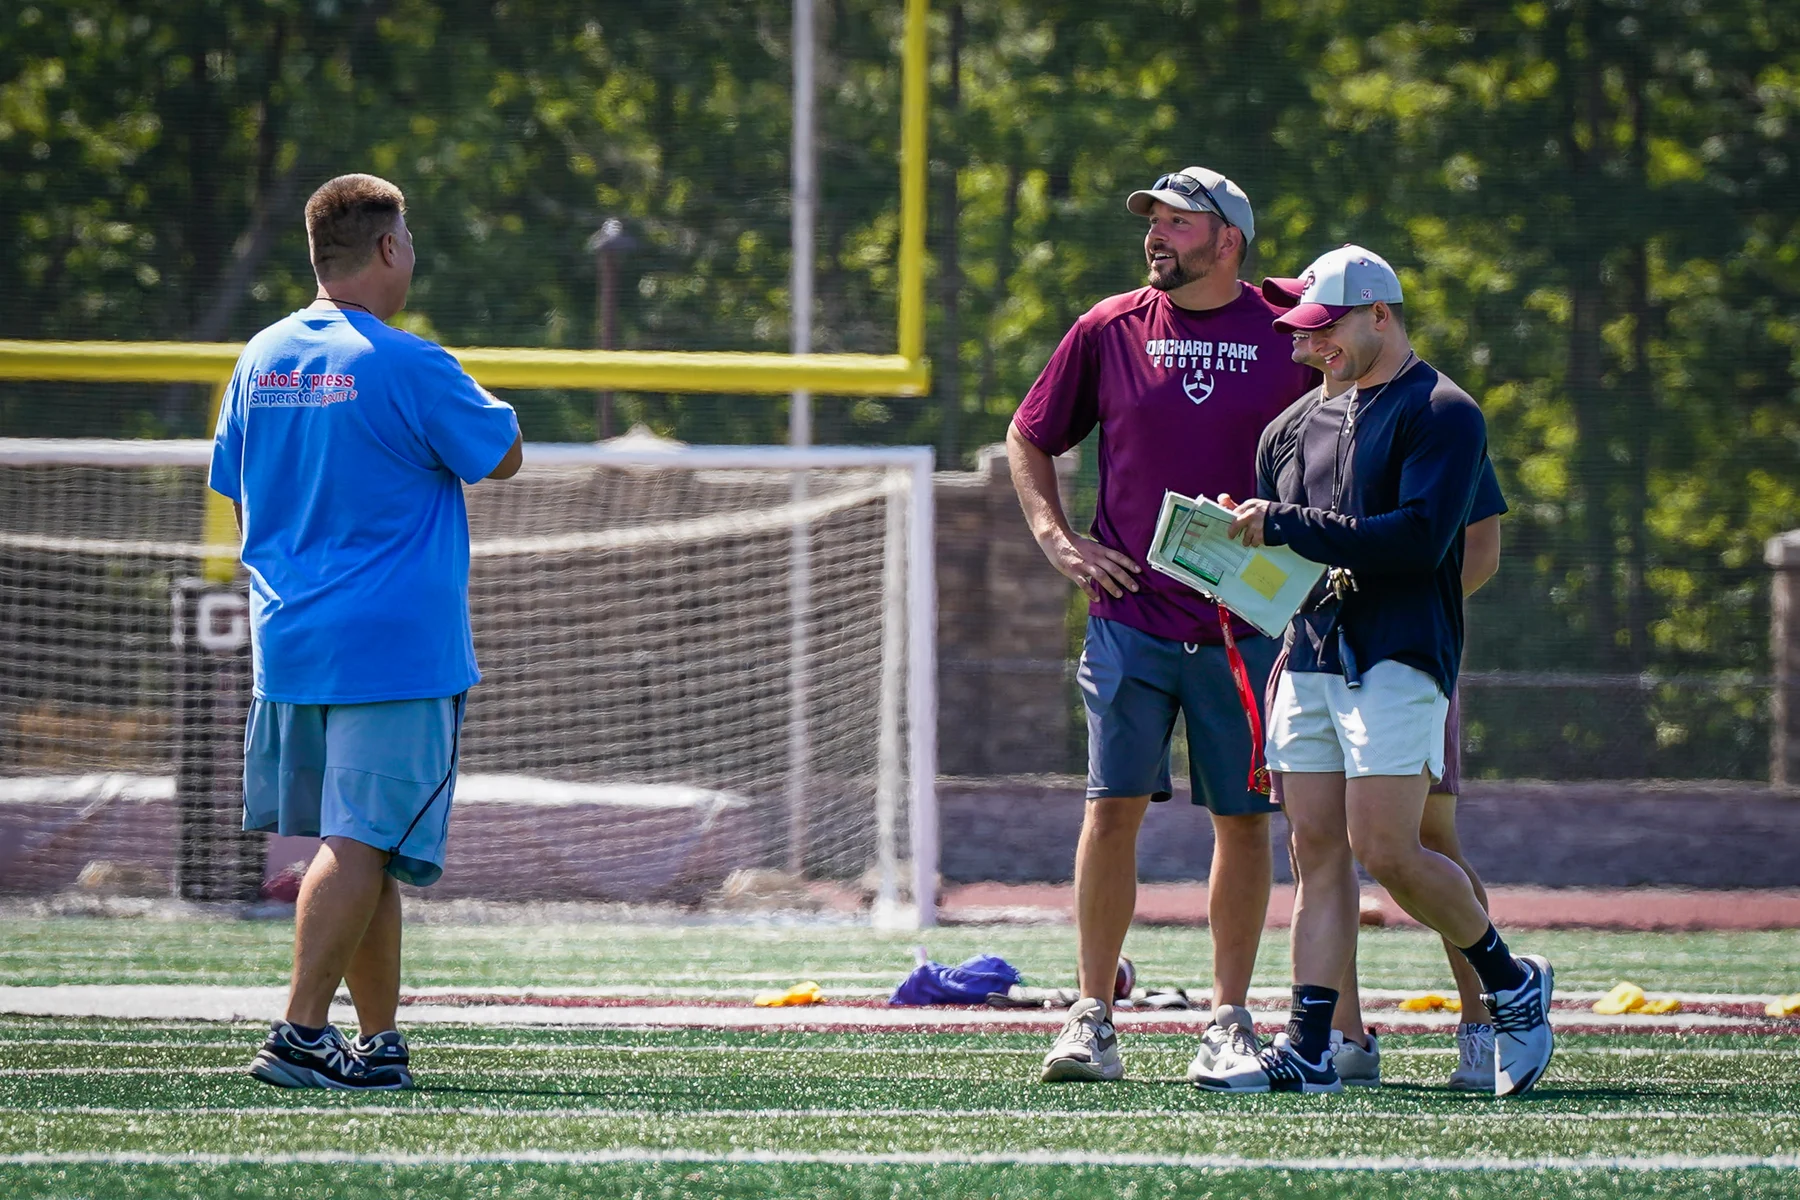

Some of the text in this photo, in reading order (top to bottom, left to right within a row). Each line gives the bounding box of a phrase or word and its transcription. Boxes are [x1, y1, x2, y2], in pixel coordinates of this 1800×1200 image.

[1146, 339, 1258, 360] ORCHARD PARK
[1153, 355, 1248, 373] FOOTBALL
[251, 390, 321, 406] Superstore
